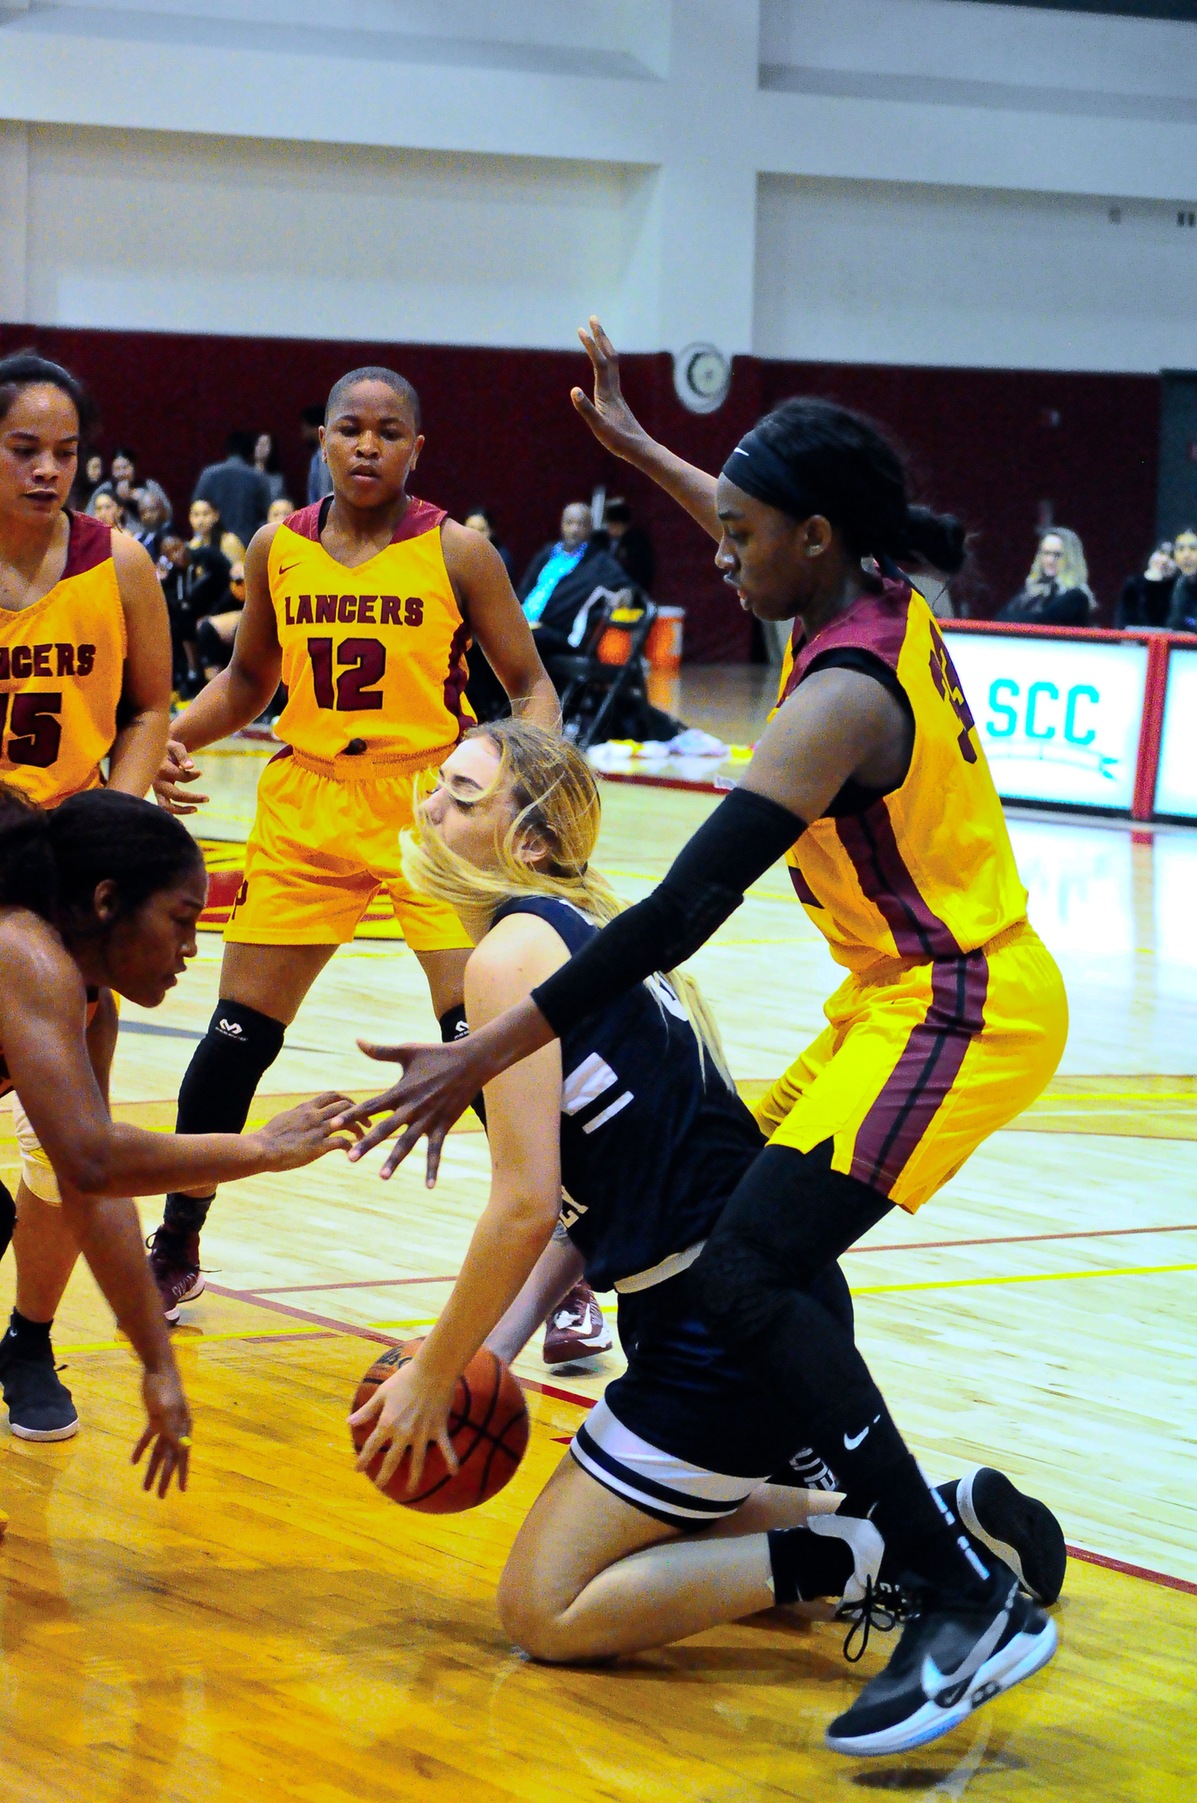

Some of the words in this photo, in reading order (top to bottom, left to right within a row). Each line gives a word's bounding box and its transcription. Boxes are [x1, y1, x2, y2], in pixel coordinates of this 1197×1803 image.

[285, 594, 424, 626] LANCERS
[307, 637, 387, 712] 12
[986, 678, 1100, 746] SCC
